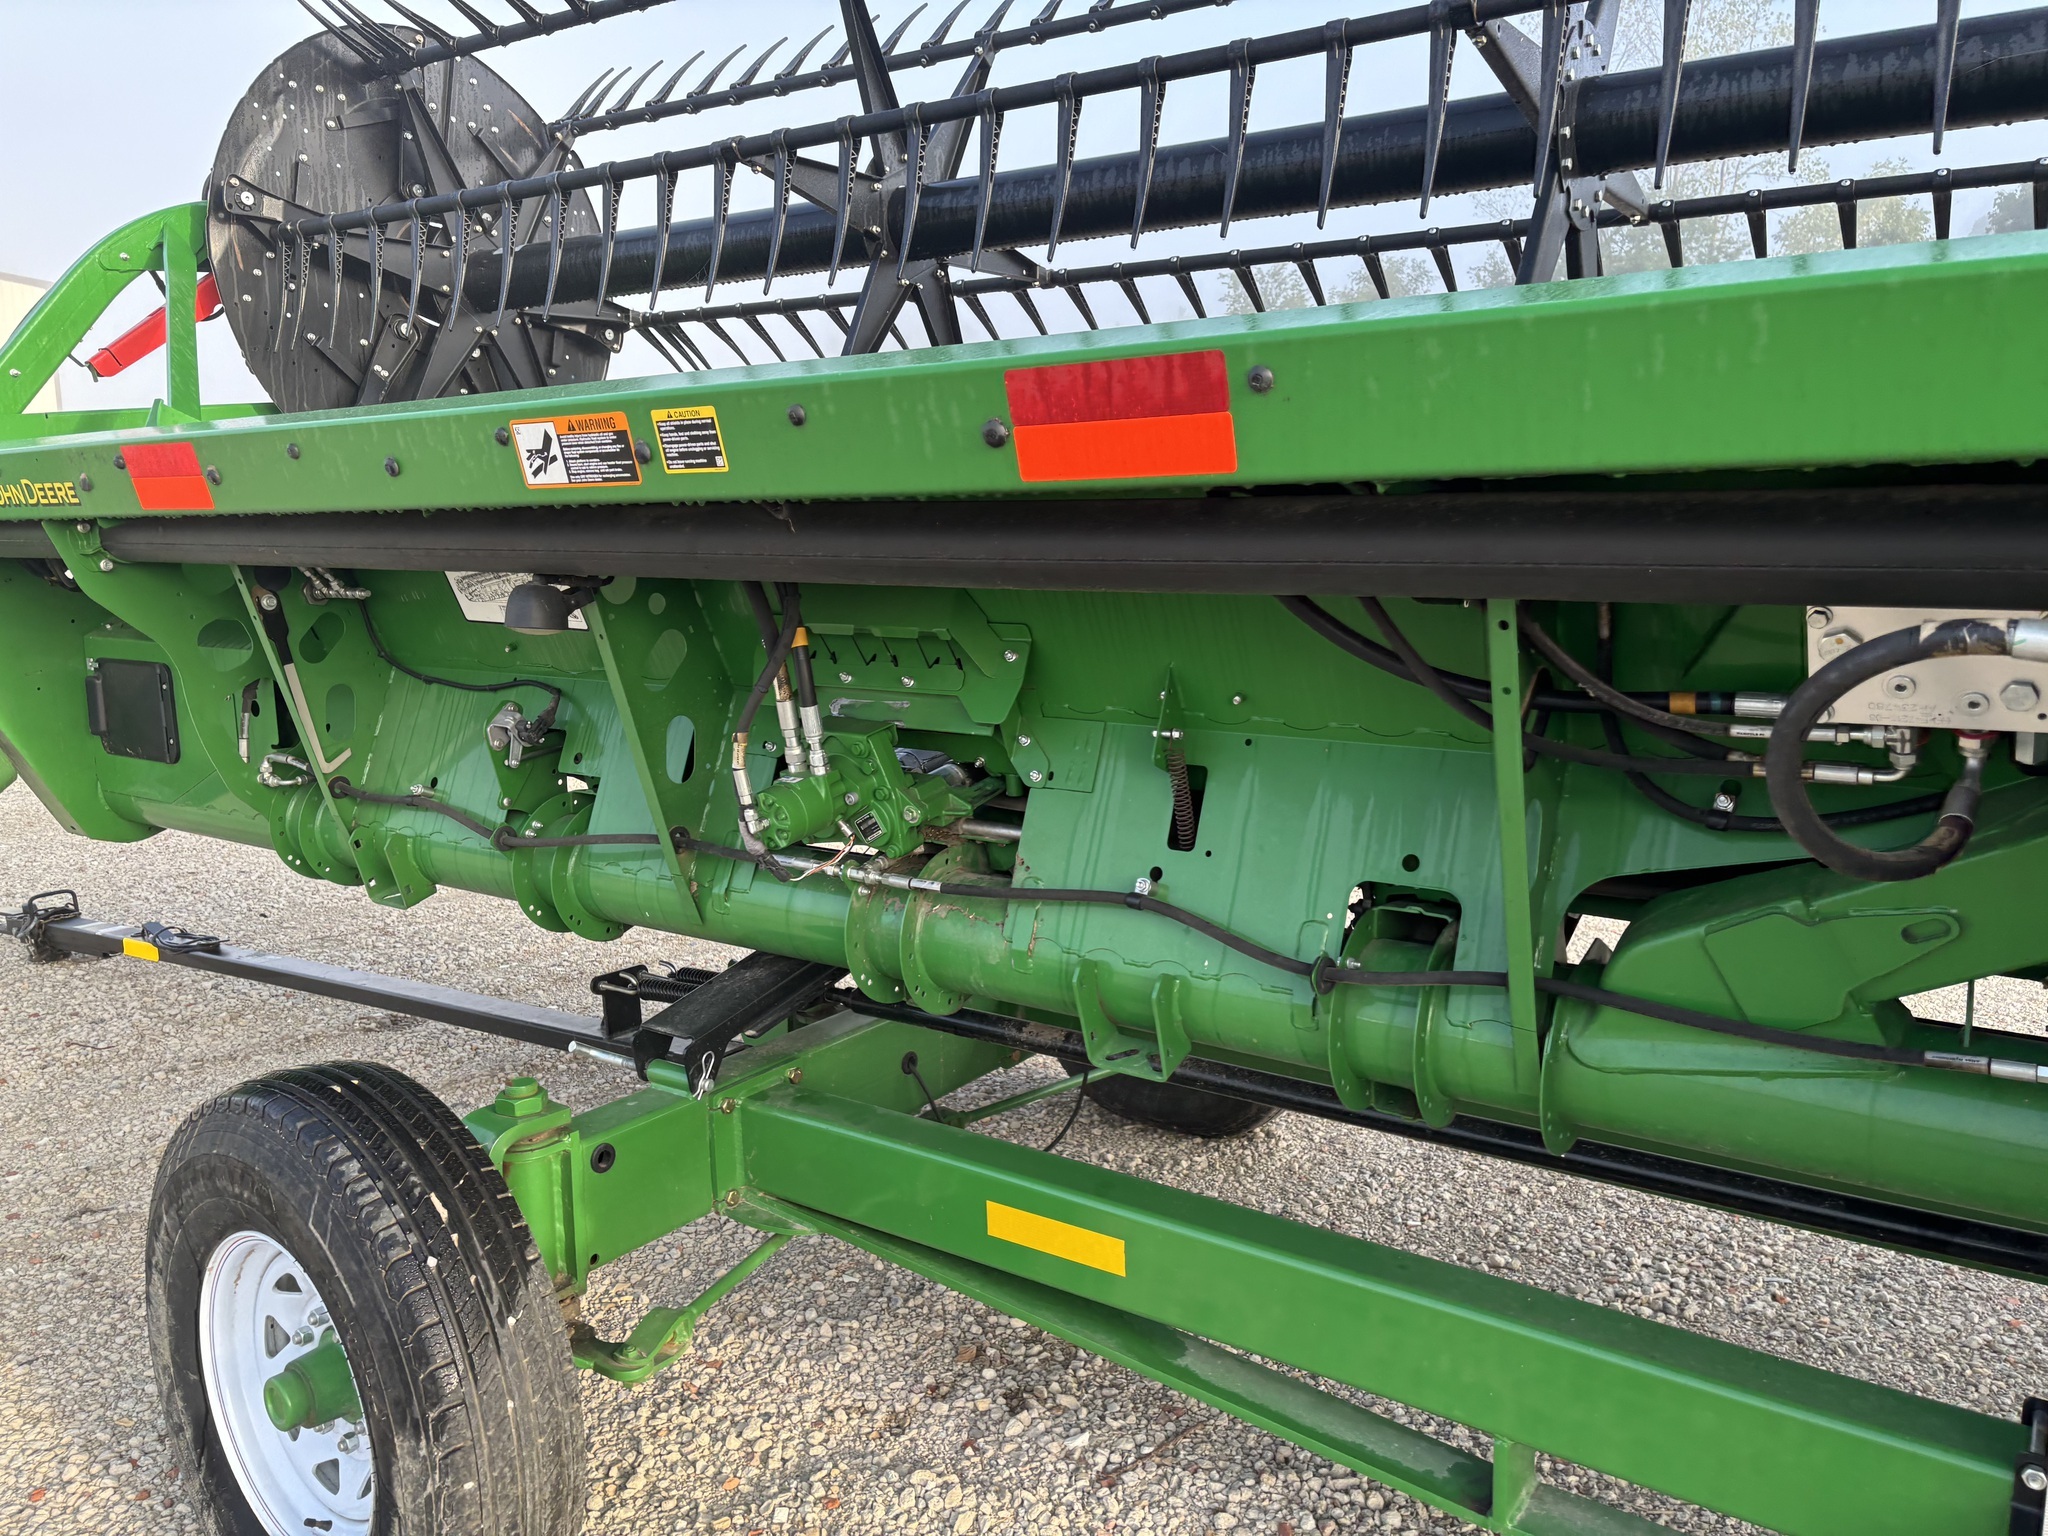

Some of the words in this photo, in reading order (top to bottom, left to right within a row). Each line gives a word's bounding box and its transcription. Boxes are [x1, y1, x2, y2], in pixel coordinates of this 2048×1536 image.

[674, 410, 700, 418] CAUTION
[575, 417, 616, 431] WARNING
[20, 479, 80, 505] DEERE
